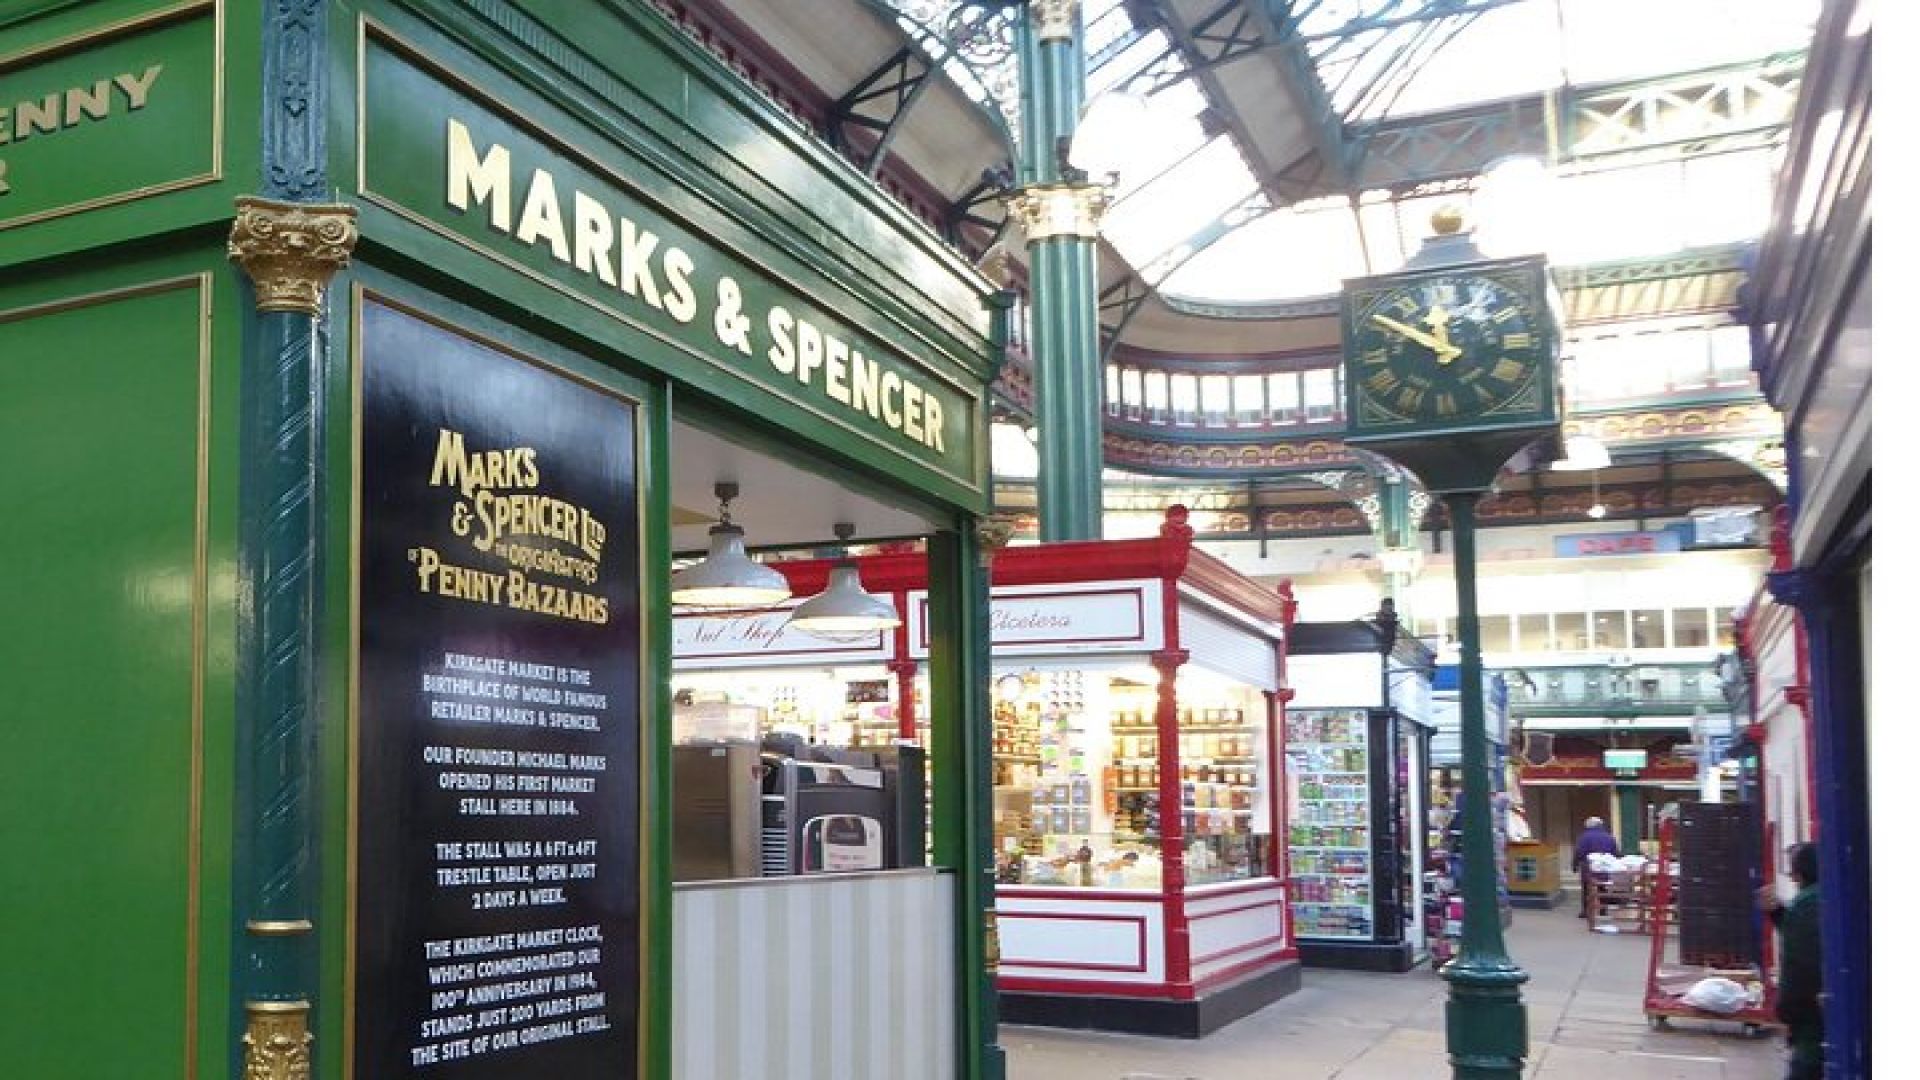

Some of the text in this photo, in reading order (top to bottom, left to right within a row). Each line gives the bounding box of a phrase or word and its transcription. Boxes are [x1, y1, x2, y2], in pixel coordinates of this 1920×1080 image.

[447, 117, 945, 454] MARKS & SPENCER
[429, 428, 539, 499] MARKS
[452, 501, 474, 536] &
[473, 490, 579, 551] SPENCER
[418, 547, 504, 604] PENNY
[507, 568, 609, 624] BAZAARS
[445, 652, 591, 686] KIRKGATE MARKET IS THE
[423, 674, 606, 710] BIRTHPLACE OF WORLD FAMOUS
[431, 701, 491, 722] RETAILER
[492, 706, 535, 725] MARKS
[423, 746, 606, 771] OUR FOUNDER MICHAEL MARKS
[439, 772, 595, 793] OPENED HIS FIRST MARKET
[459, 798, 497, 815] STALL
[498, 798, 531, 815] HERE
[532, 799, 547, 815] IN
[436, 843, 462, 861] THE
[464, 841, 502, 858] STALL
[503, 841, 531, 858] WAS
[533, 840, 542, 858] A
[436, 866, 491, 886] TRESTLE
[535, 864, 568, 881] OPEN
[570, 863, 597, 879] JUST
[484, 890, 515, 909] DAYS
[519, 890, 529, 906] A
[424, 939, 451, 960] THE
[452, 933, 515, 957] KIRKGATE
[516, 928, 563, 949] MARKET
[428, 948, 600, 984] WHICH COMMEMORATED OUR
[464, 976, 552, 1006] ANNIVERSARY
[553, 975, 566, 991] IN
[421, 991, 606, 1038] STANDS JUST 200 YARDS FROM
[411, 1043, 438, 1067] THE
[442, 1039, 470, 1060] SITE
[471, 1034, 489, 1054] OF
[492, 1030, 518, 1050] OUR
[519, 1020, 574, 1045] ORIGINAL
